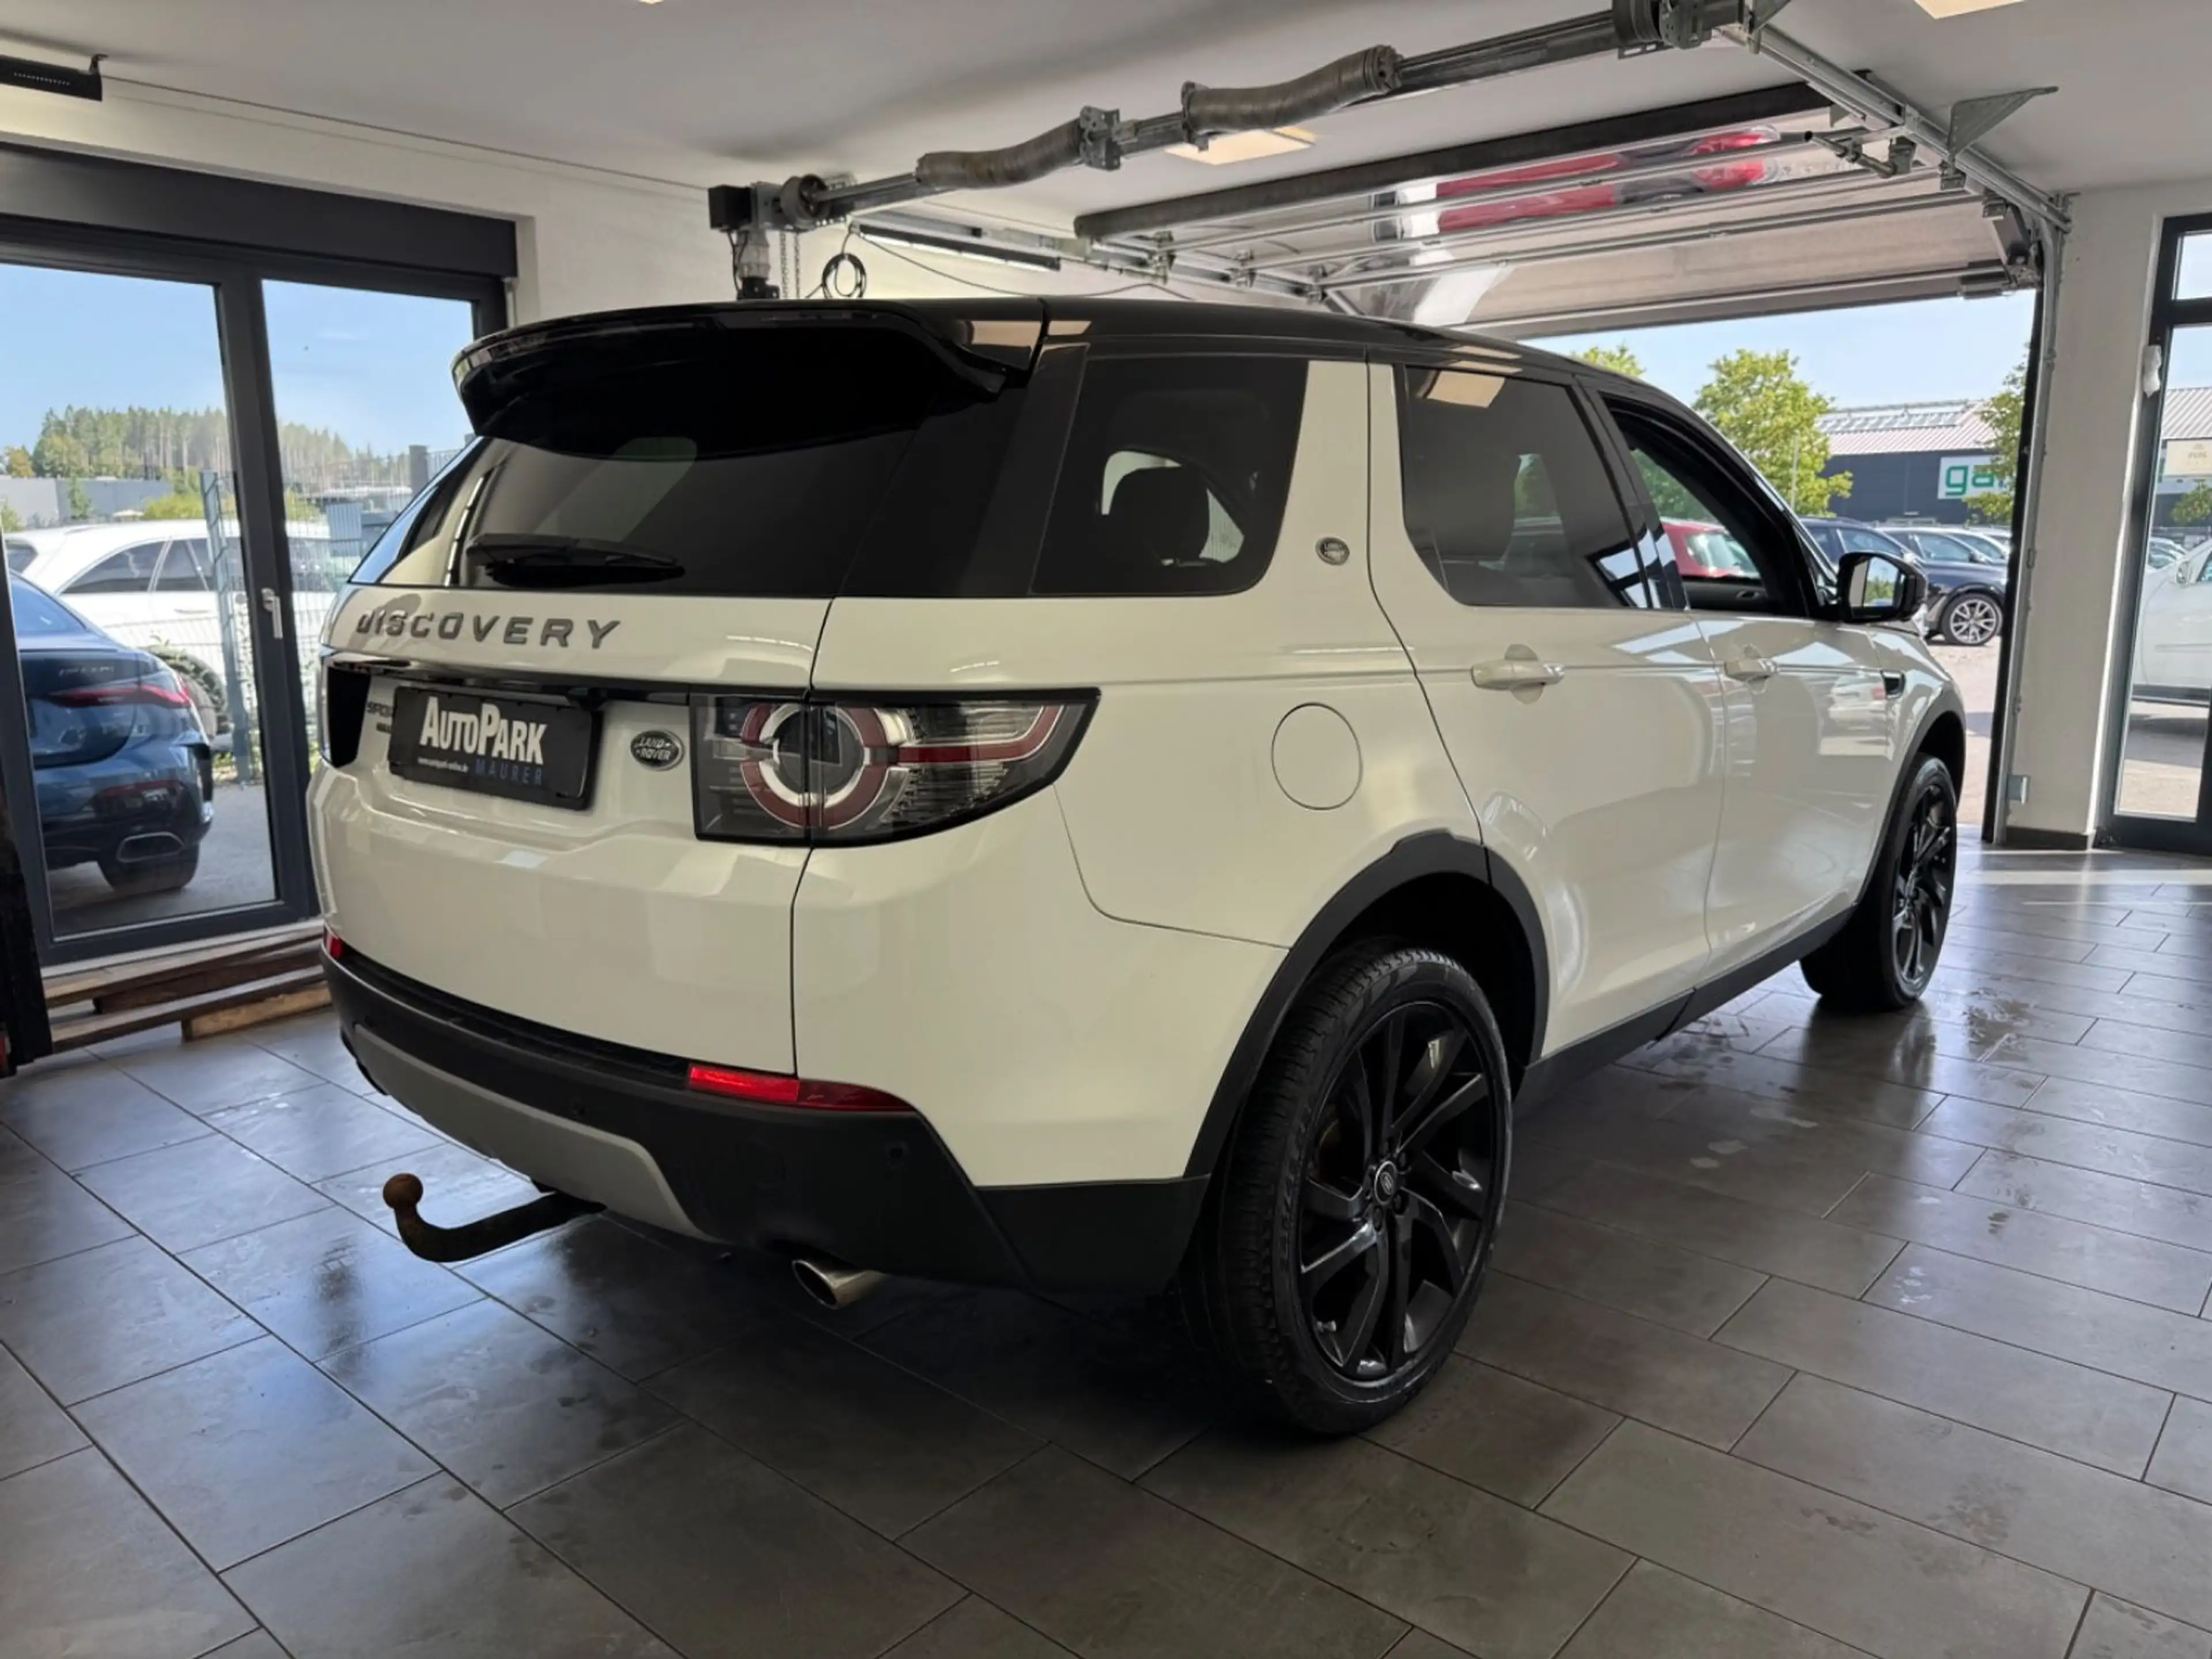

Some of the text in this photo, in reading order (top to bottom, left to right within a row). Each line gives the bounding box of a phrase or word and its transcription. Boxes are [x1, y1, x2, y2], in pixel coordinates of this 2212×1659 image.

[1945, 465, 2006, 496] ga
[355, 610, 621, 649] DISCOVERY
[641, 748, 671, 760] ROVER
[475, 758, 542, 785] MAURER
